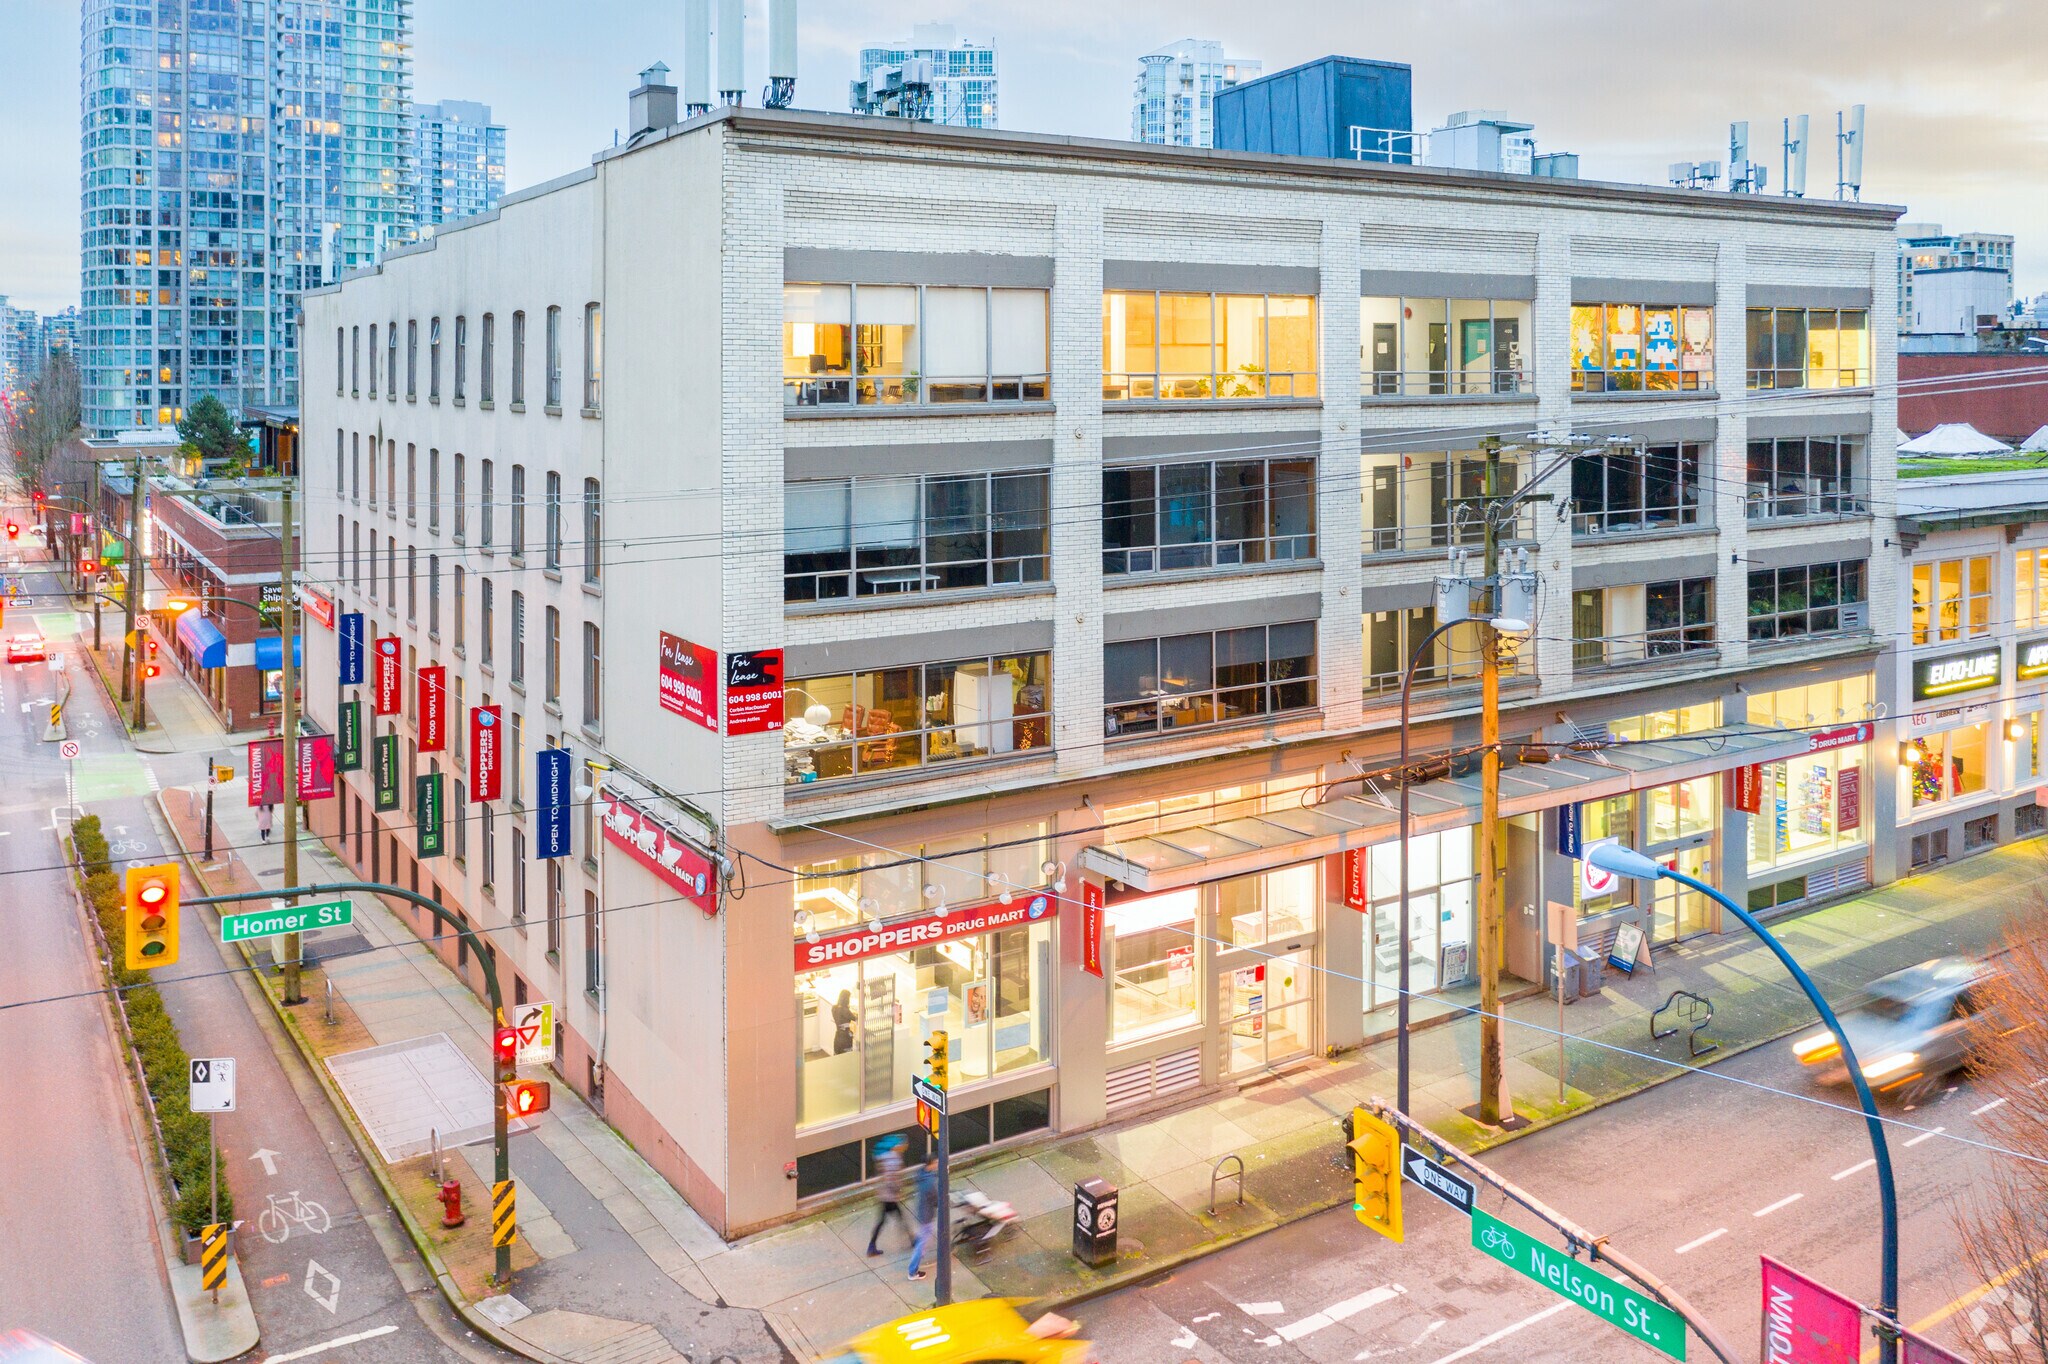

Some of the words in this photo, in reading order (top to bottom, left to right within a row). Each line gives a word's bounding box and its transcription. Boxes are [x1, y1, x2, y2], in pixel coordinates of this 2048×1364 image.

[350, 651, 356, 661] TO
[660, 636, 674, 658] For
[674, 642, 695, 666] Lease
[731, 654, 751, 669] For
[383, 656, 391, 712] SHOPPERS
[731, 670, 759, 685] Lease
[1929, 654, 1998, 685] EURO-LINE
[661, 673, 673, 692] 604
[673, 678, 686, 697] 998
[686, 684, 703, 705] 6001
[728, 694, 744, 705] 604
[745, 692, 761, 703] 998
[762, 690, 782, 701] 6001
[1818, 738, 1837, 748] DRUG
[1837, 733, 1857, 744] MART
[253, 747, 262, 793] YALETOWN
[302, 743, 312, 788] YALETOWN
[480, 729, 488, 797] SHOPPERS
[552, 807, 559, 822] TO
[1569, 822, 1574, 832] TO
[551, 824, 559, 852] OPEN
[605, 812, 658, 860] SHPPRS
[675, 866, 695, 887] MART
[233, 914, 307, 936] Homer
[318, 906, 342, 924] St
[807, 921, 943, 964] SHOPPERS
[946, 917, 985, 935] DRUG
[988, 909, 1026, 926] MART
[519, 1053, 550, 1063] BICYCLES
[1424, 1167, 1442, 1187] ONE
[1446, 1180, 1465, 1200] WAY
[1531, 1247, 1614, 1315] Nelson
[1624, 1298, 1661, 1341] St.
[1768, 1285, 1794, 1364] TOWN
